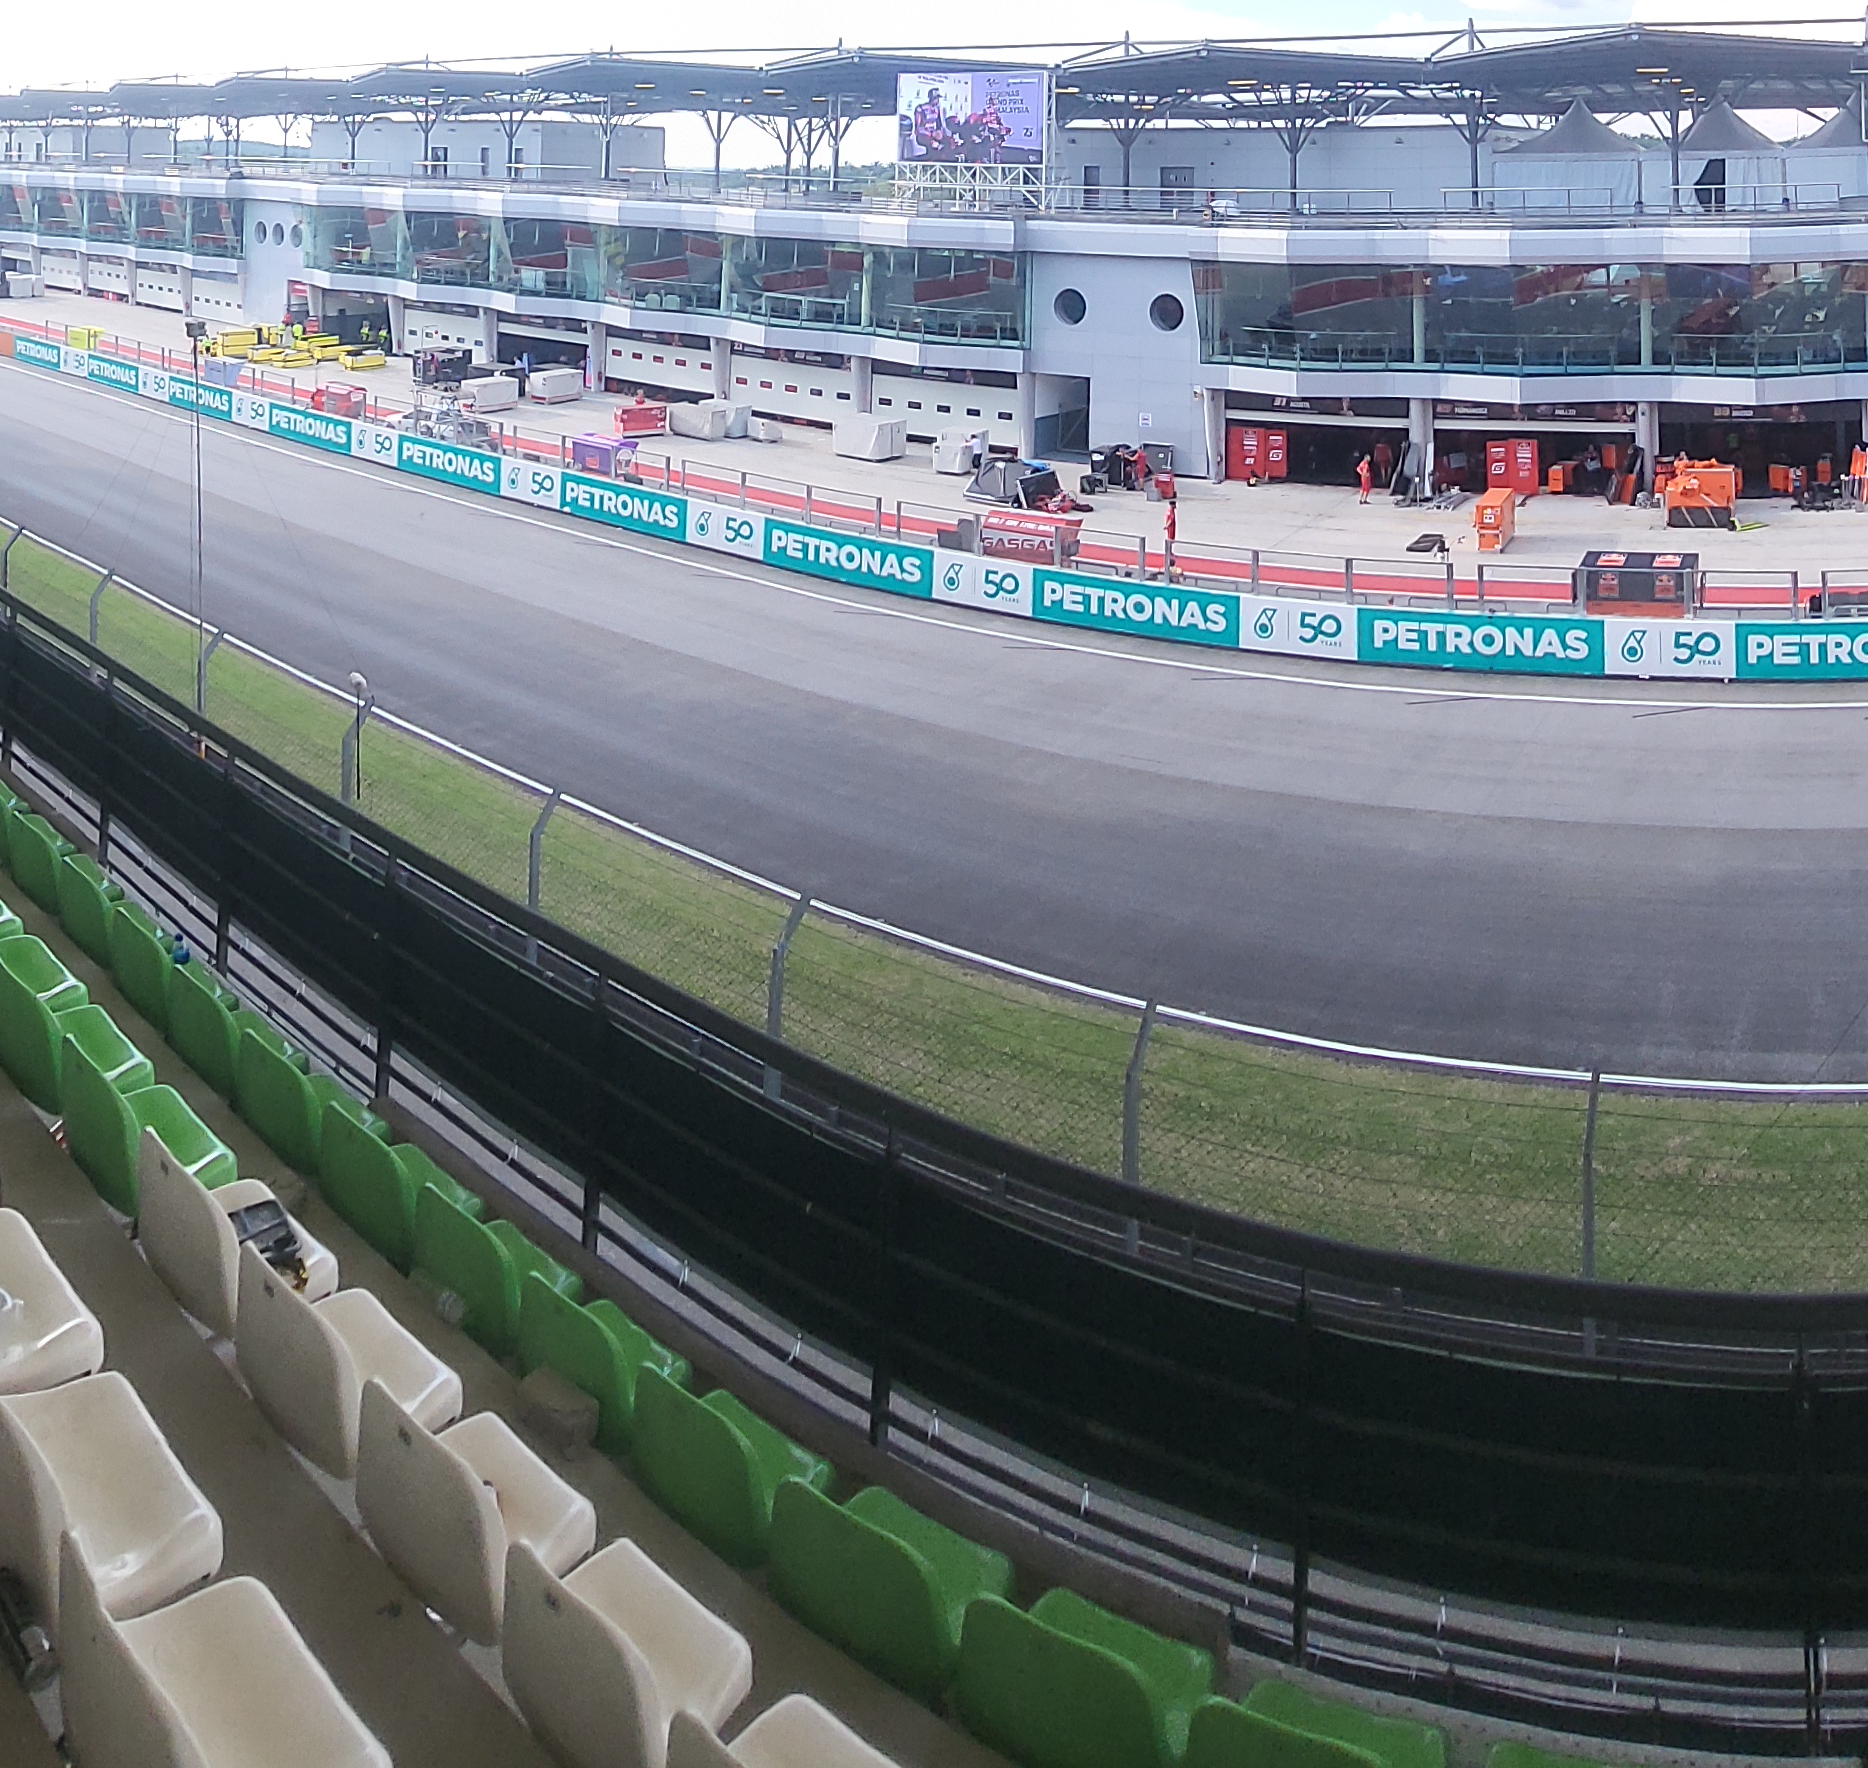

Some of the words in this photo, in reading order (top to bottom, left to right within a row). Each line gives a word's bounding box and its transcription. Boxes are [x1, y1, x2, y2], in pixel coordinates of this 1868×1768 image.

[16, 339, 59, 364] PETRONAS
[73, 352, 86, 370] 50
[88, 359, 137, 386] PETRONAS
[153, 374, 166, 393] 50
[169, 381, 230, 412] PETRONAS
[250, 401, 265, 420] 50
[272, 408, 348, 445] PETRONAS
[374, 434, 394, 455] 50
[401, 441, 495, 483] PETRONAS
[530, 471, 555, 496] 50
[565, 481, 679, 529] PETRONAS
[724, 516, 754, 544] 50
[771, 528, 922, 583] PETRONAS
[983, 569, 1020, 600] 50
[1043, 581, 1227, 633] PETRONAS
[1298, 611, 1342, 644] 50
[1373, 619, 1589, 660] PETRONAS
[1320, 639, 1343, 648] YEARS
[1672, 631, 1722, 665] 50
